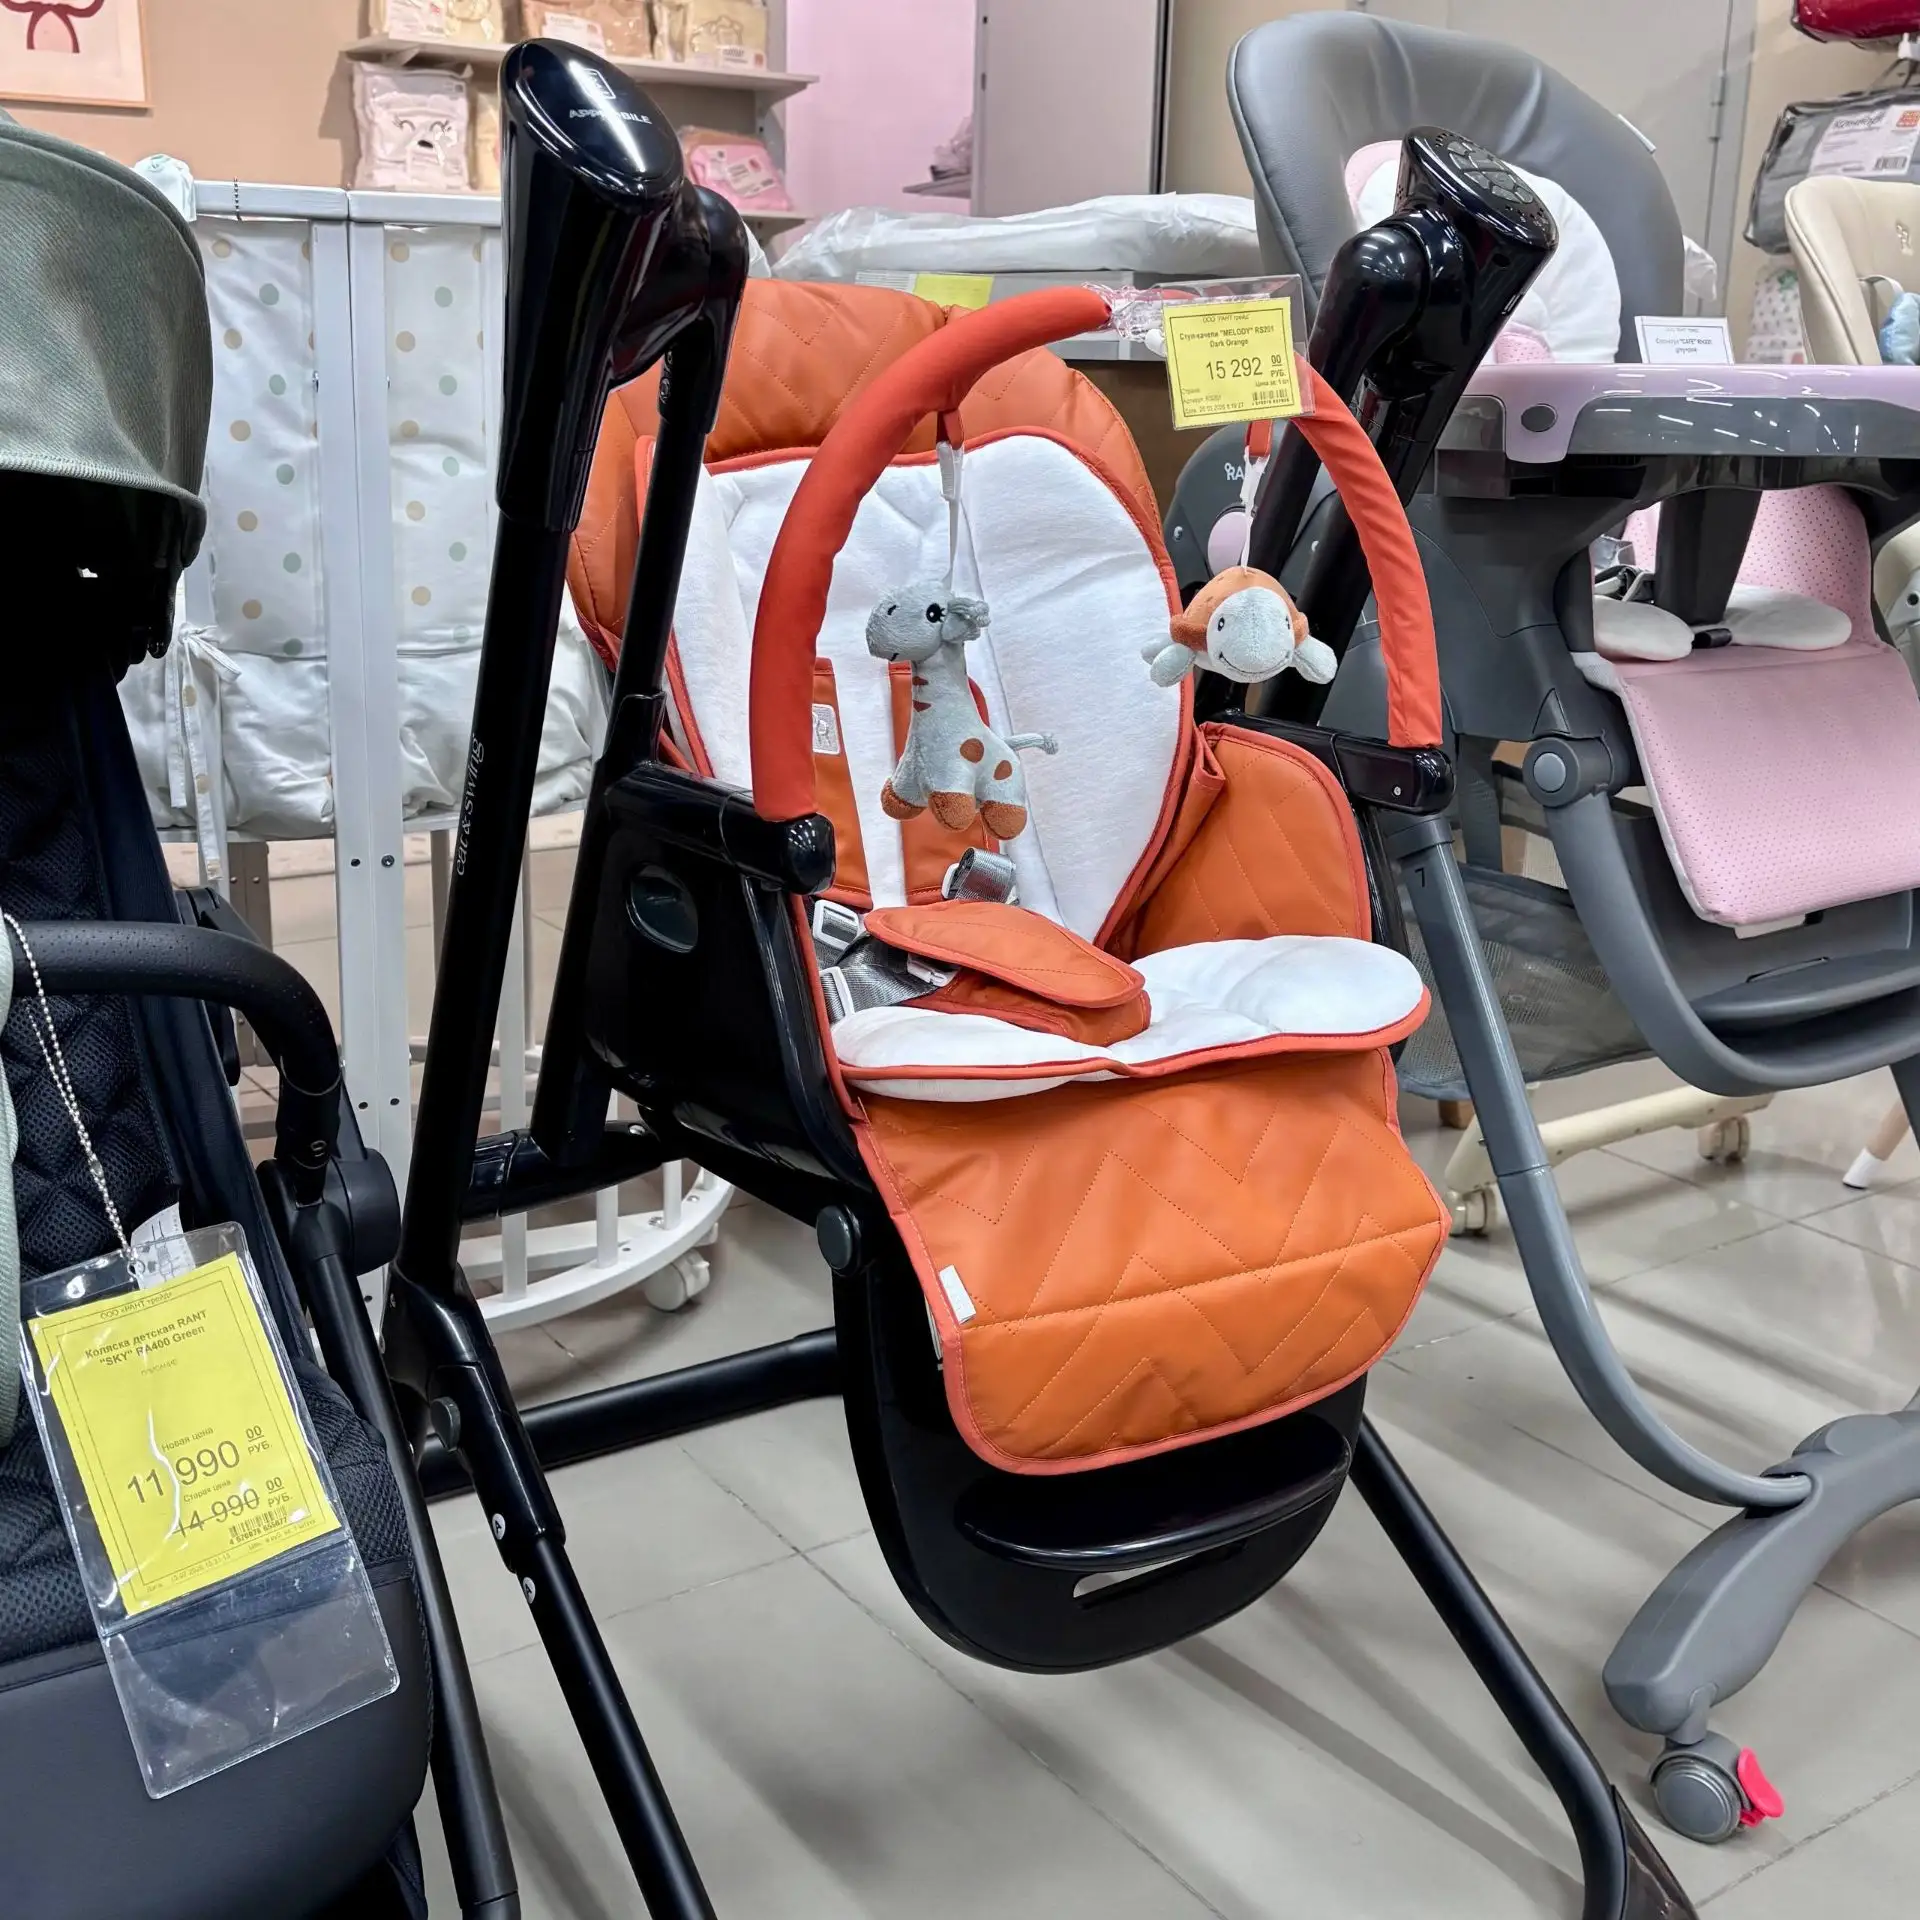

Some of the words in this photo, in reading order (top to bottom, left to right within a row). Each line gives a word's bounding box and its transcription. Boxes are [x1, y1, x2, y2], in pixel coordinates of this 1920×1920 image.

[1220, 327, 1253, 337] "MELODY"
[1209, 340, 1224, 348] Dark
[1226, 339, 1248, 348] Orange
[1271, 354, 1282, 364] 00
[1206, 361, 1226, 380] 15
[1230, 357, 1263, 378] 292
[100, 1309, 119, 1320] ООО
[85, 1339, 131, 1359] Коляска
[133, 1323, 176, 1346] детская
[176, 1309, 207, 1329] RANT
[100, 1350, 132, 1367] "SKY"
[135, 1337, 171, 1357] RA400
[172, 1325, 205, 1343] Green
[245, 1425, 263, 1439] 00
[161, 1437, 191, 1453] Новая
[191, 1427, 214, 1441] цена
[247, 1440, 273, 1455] РУБ.
[127, 1468, 164, 1503] 11
[175, 1440, 240, 1486] 990
[183, 1487, 212, 1503] Старая
[212, 1479, 232, 1492] цена
[265, 1477, 283, 1491] 00
[268, 1493, 293, 1508] РУБ.
[177, 1510, 205, 1538] 14
[211, 1488, 260, 1523] 990
